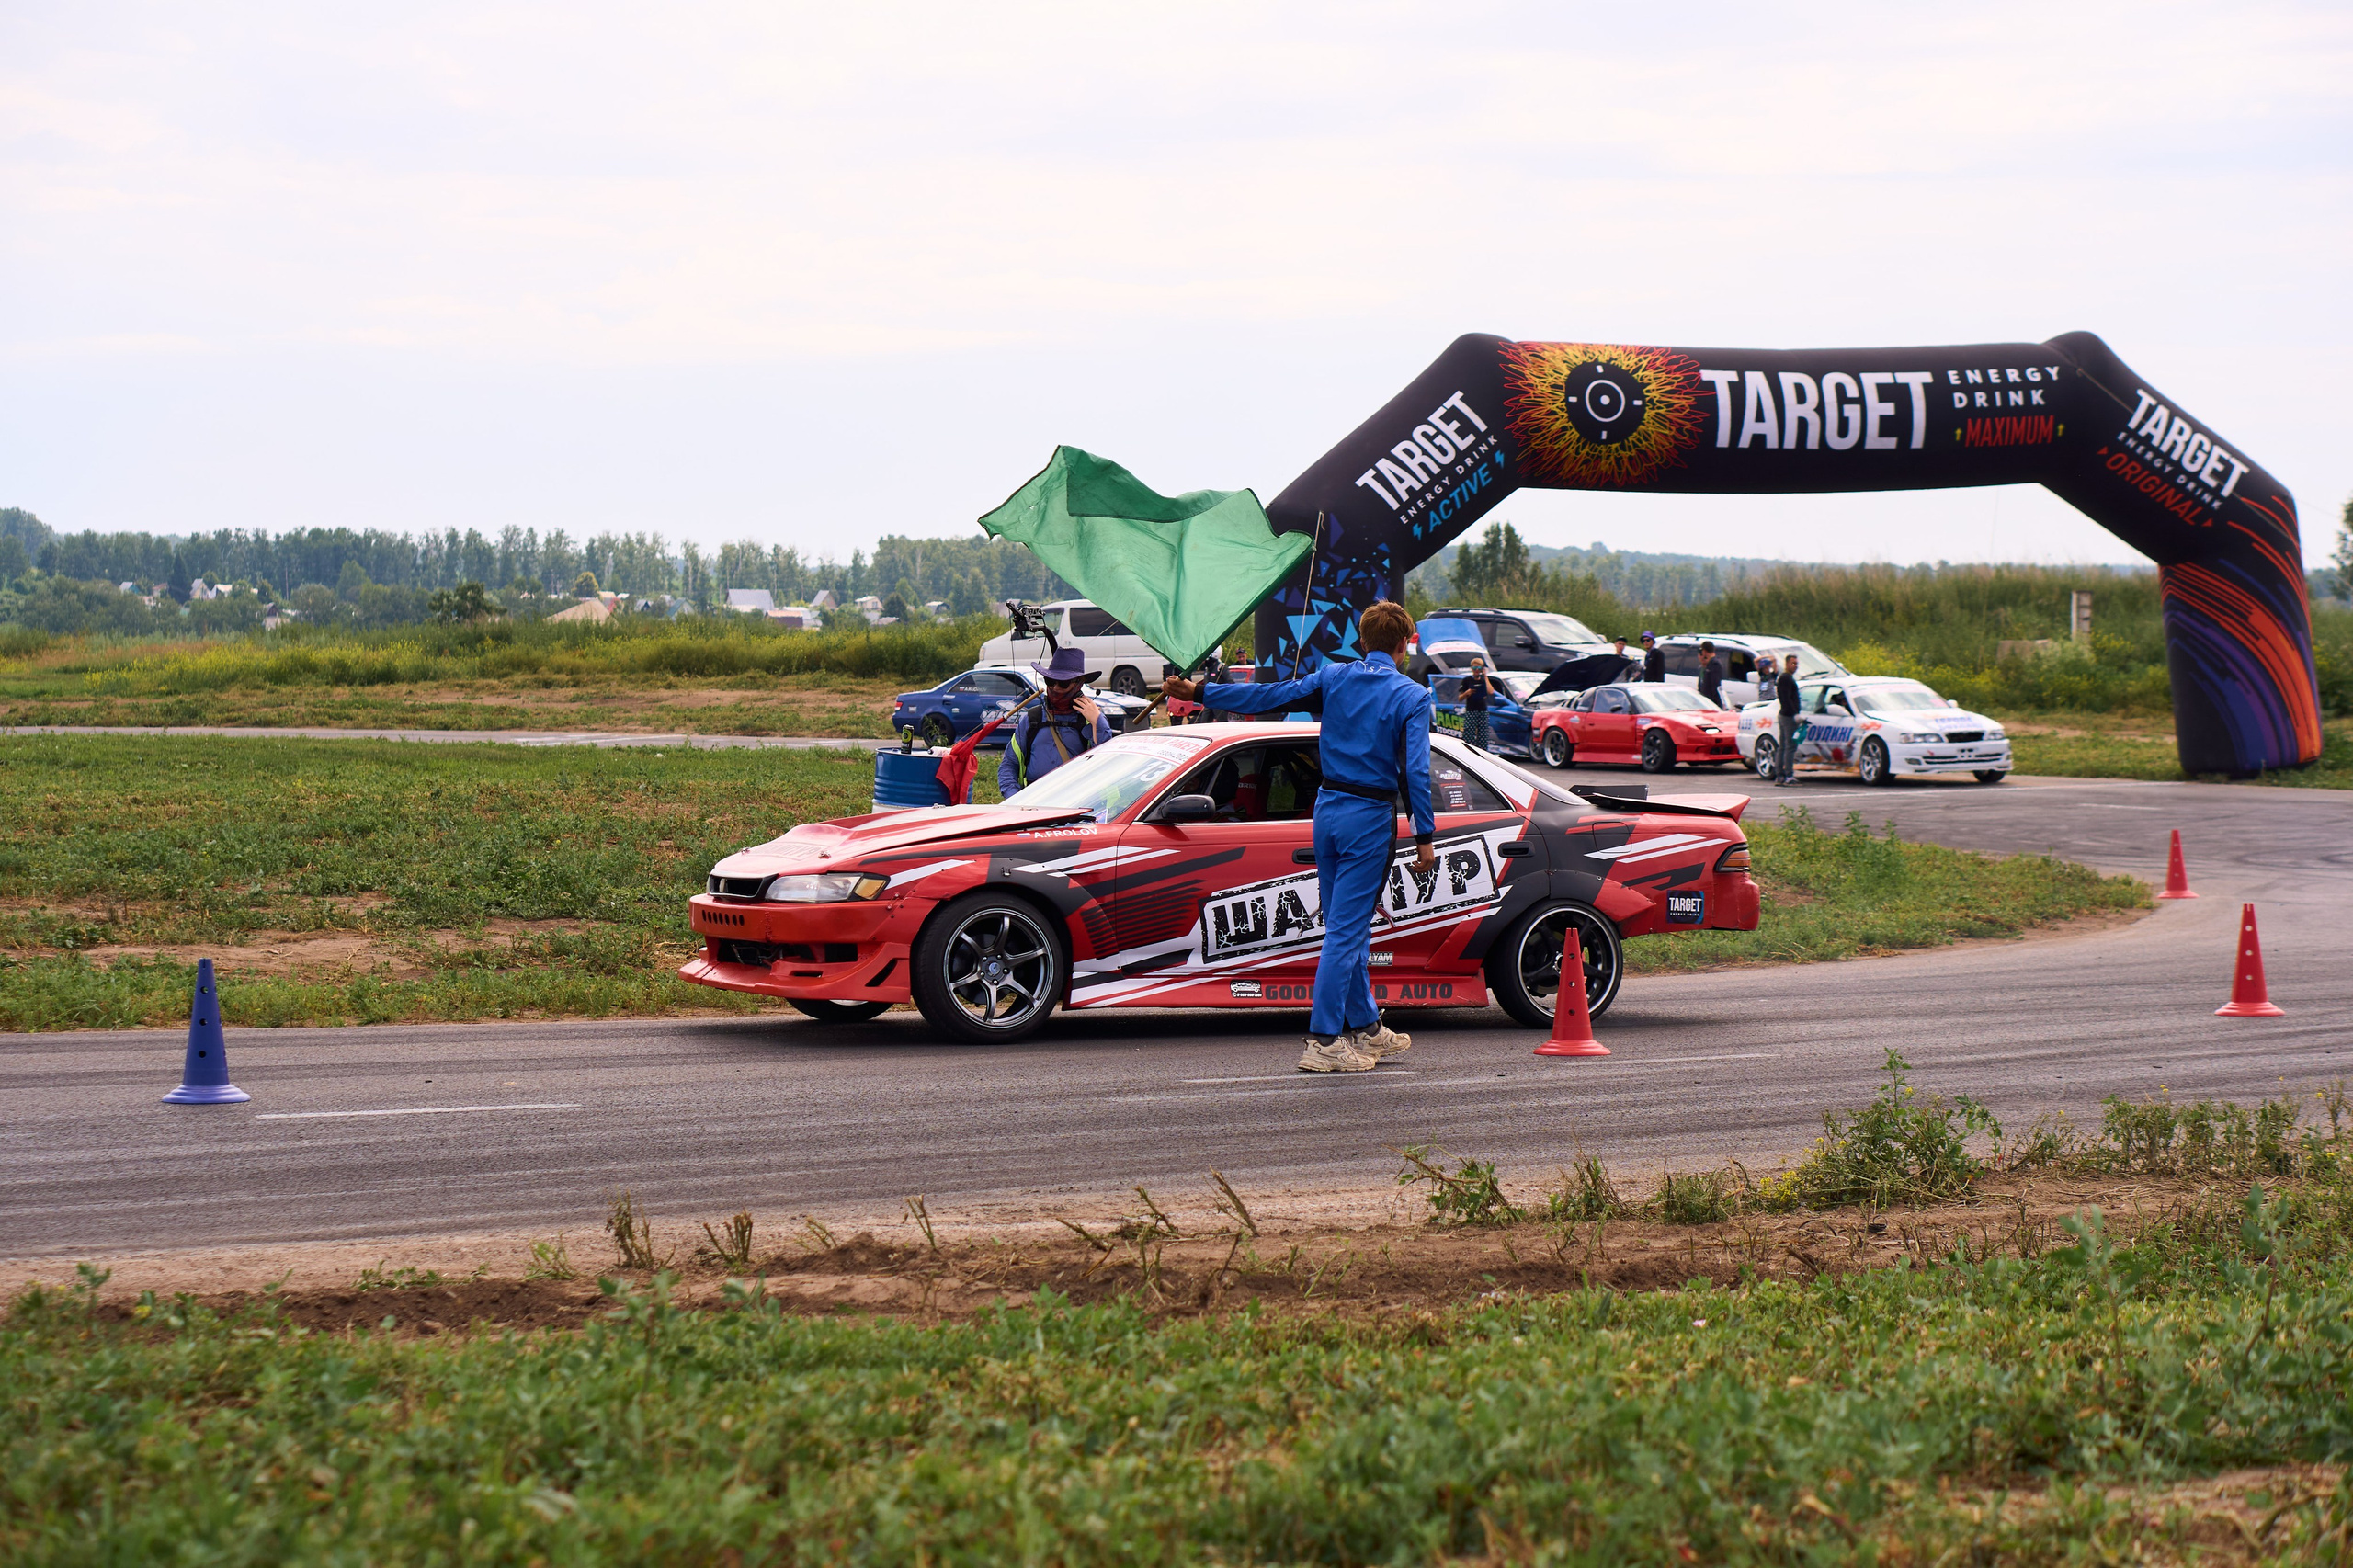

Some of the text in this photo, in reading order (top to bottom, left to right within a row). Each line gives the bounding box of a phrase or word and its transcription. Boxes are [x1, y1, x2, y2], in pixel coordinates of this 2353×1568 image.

[1700, 369, 1934, 450] TARGET
[1947, 366, 2061, 385] ENERGY
[1952, 389, 2046, 409] DRINK
[1354, 390, 1488, 511] TARGET
[1965, 415, 2054, 448] MAXIMUM
[2127, 388, 2250, 497] TARGET
[1399, 435, 1498, 525] ENERGY DRINK
[1428, 462, 1493, 533] ACTIVE
[2105, 452, 2203, 526] ORIGINAL
[2117, 432, 2223, 510] ENERGY DRINK
[1806, 724, 1854, 743] ОУЛИНГ
[1034, 828, 1097, 838] A.FROLOV
[1211, 850, 1482, 950] ШАУР
[1668, 897, 1703, 912] TARGET
[1265, 984, 1313, 1001] GOO
[1400, 983, 1453, 1000] AUTO
